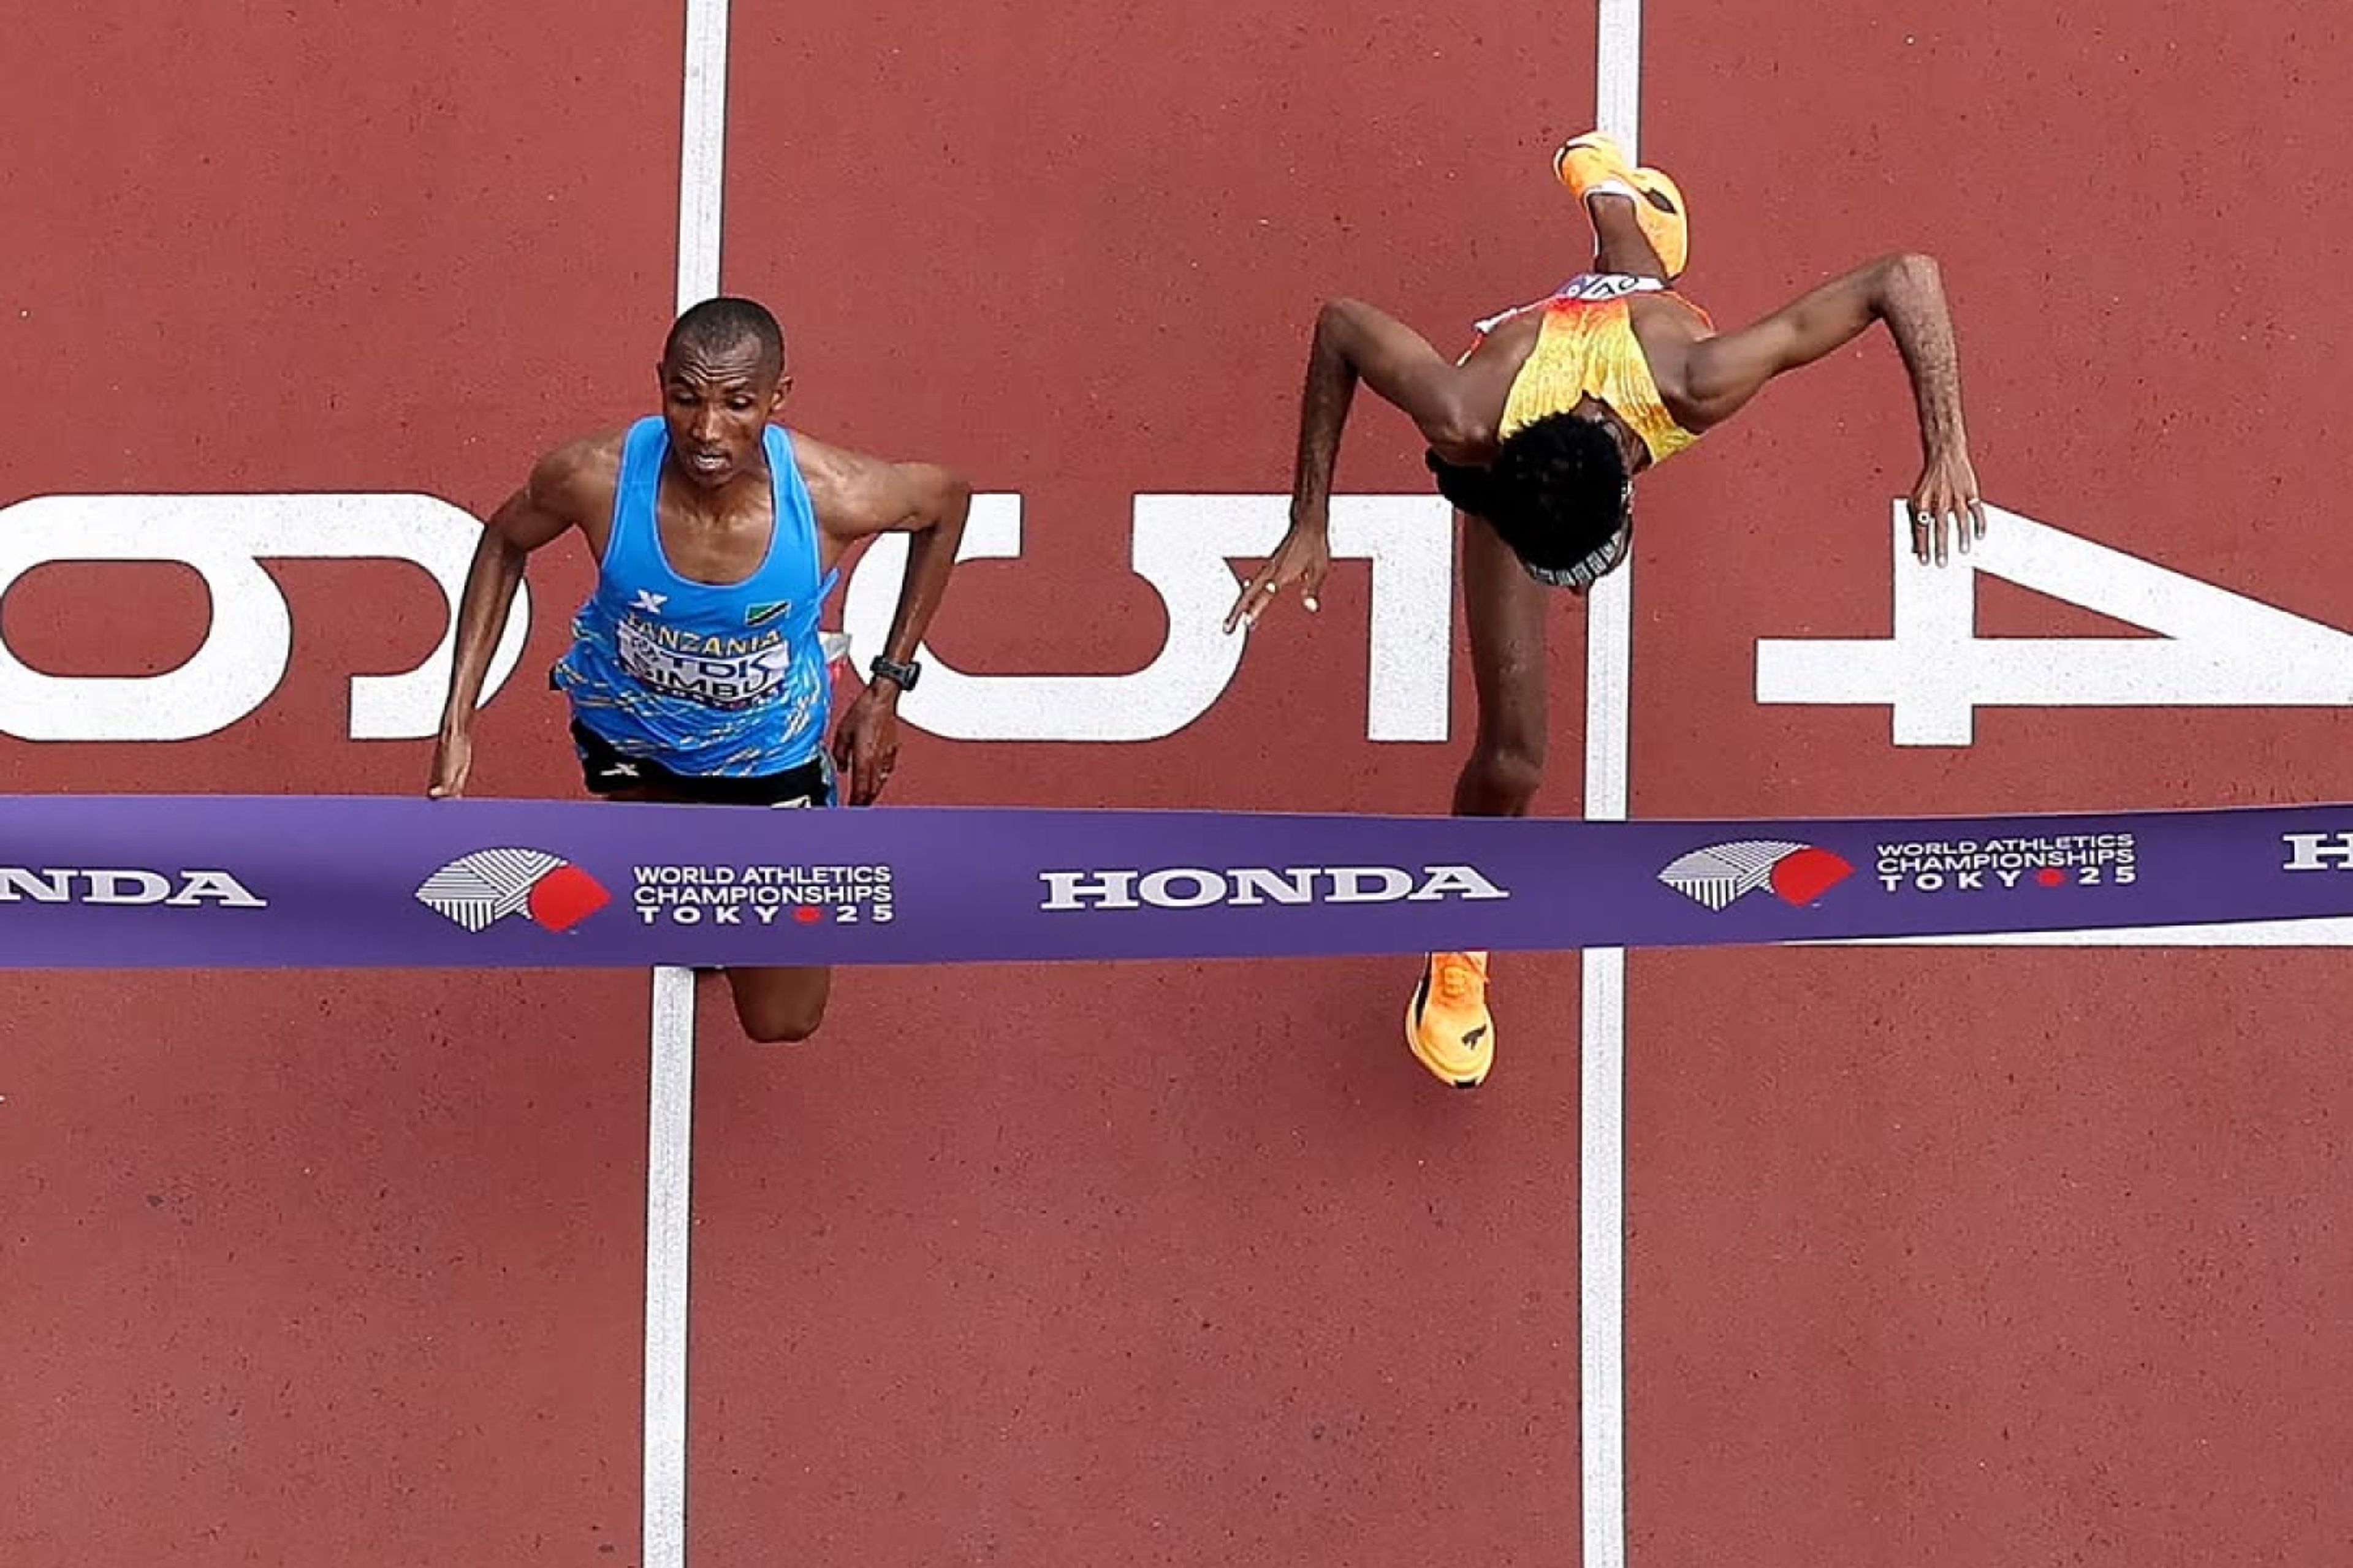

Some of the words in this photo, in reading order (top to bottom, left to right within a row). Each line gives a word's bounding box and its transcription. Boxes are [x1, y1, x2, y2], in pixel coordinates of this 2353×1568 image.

[626, 610, 782, 657] TANZANIA
[843, 493, 1453, 742] 5
[1755, 496, 2353, 746] 4
[1877, 841, 1979, 857] WORLD
[1984, 833, 2134, 852] ATHLETICS
[1877, 849, 2135, 873] CHAMPIONSHIPS
[633, 866, 736, 885] WORLD
[740, 866, 892, 885] ATHLETICS
[1039, 866, 1510, 909] HONDA
[633, 885, 892, 904] CHAMPIONSHIPS
